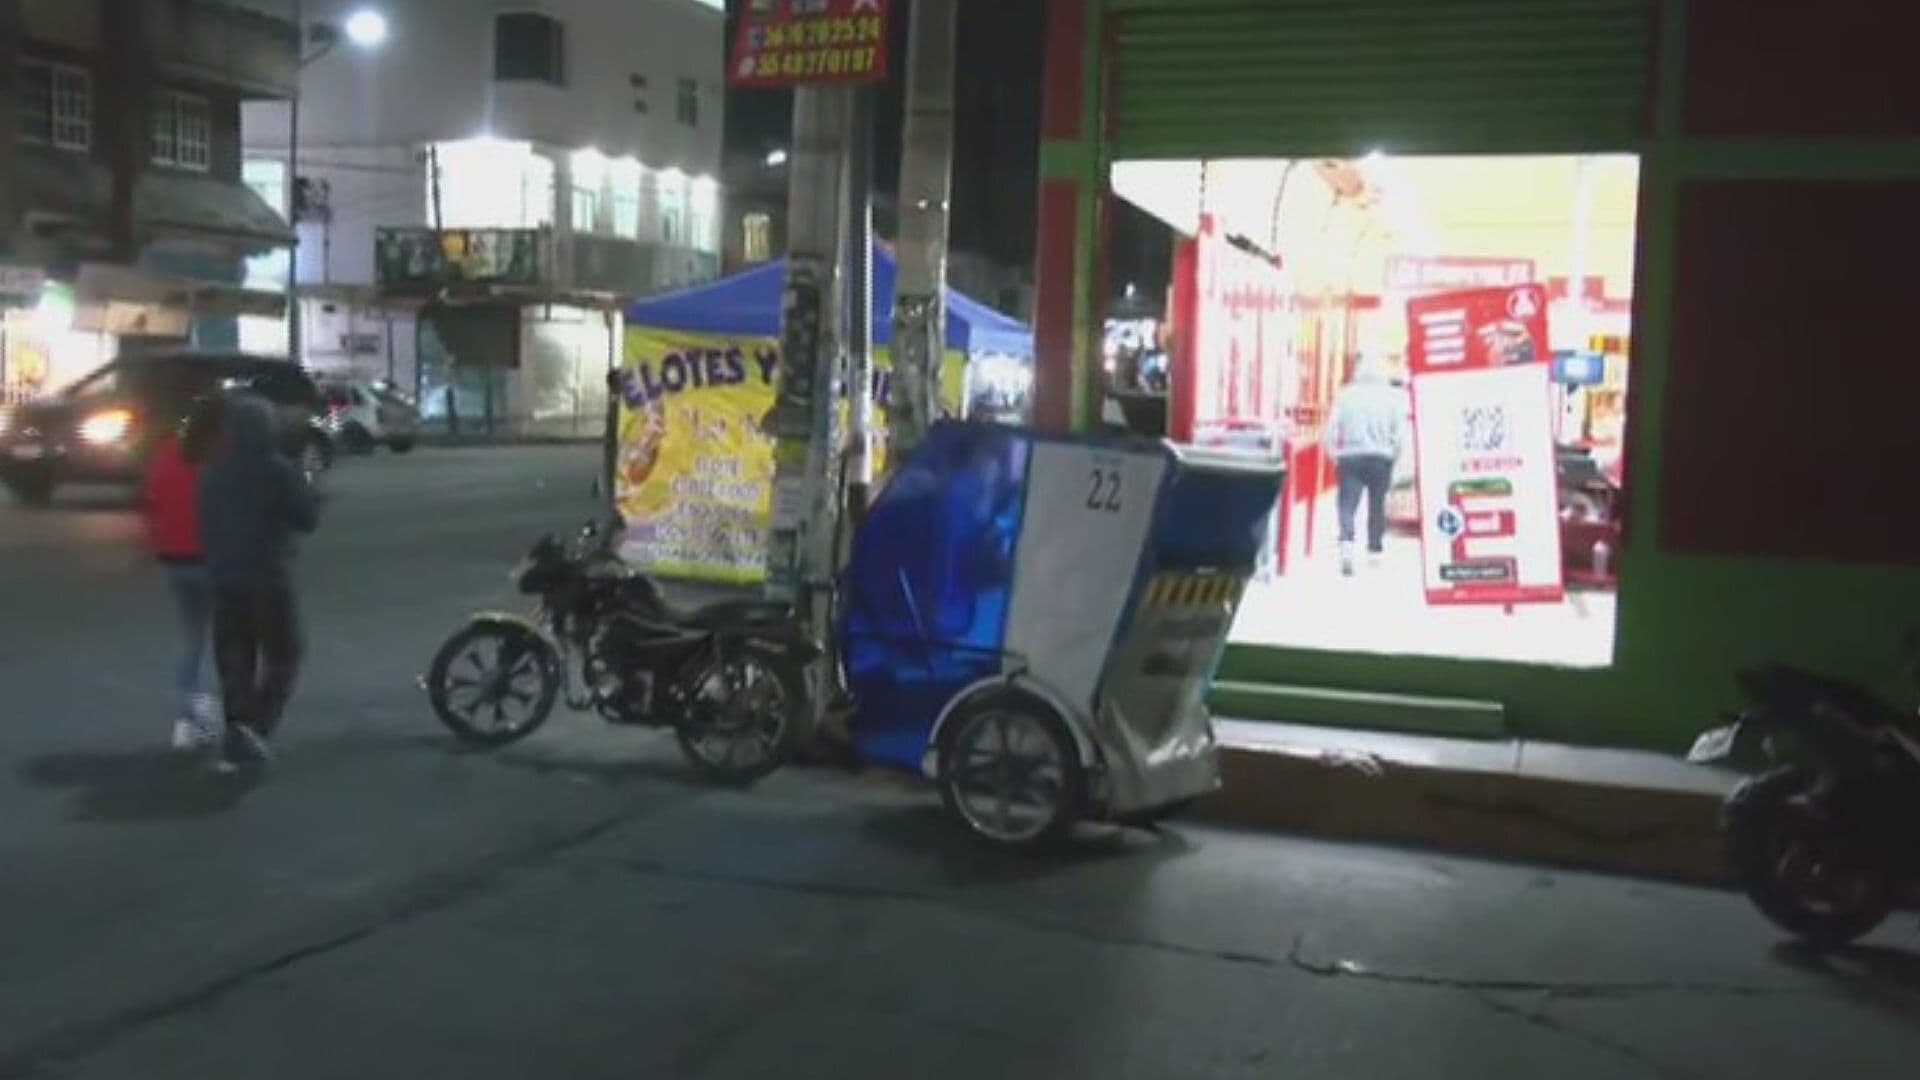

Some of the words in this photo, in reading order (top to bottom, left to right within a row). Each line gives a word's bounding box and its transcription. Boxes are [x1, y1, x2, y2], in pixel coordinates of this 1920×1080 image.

[621, 346, 745, 407] ELOTES
[755, 348, 778, 386] Y
[1086, 468, 1122, 512] 22
